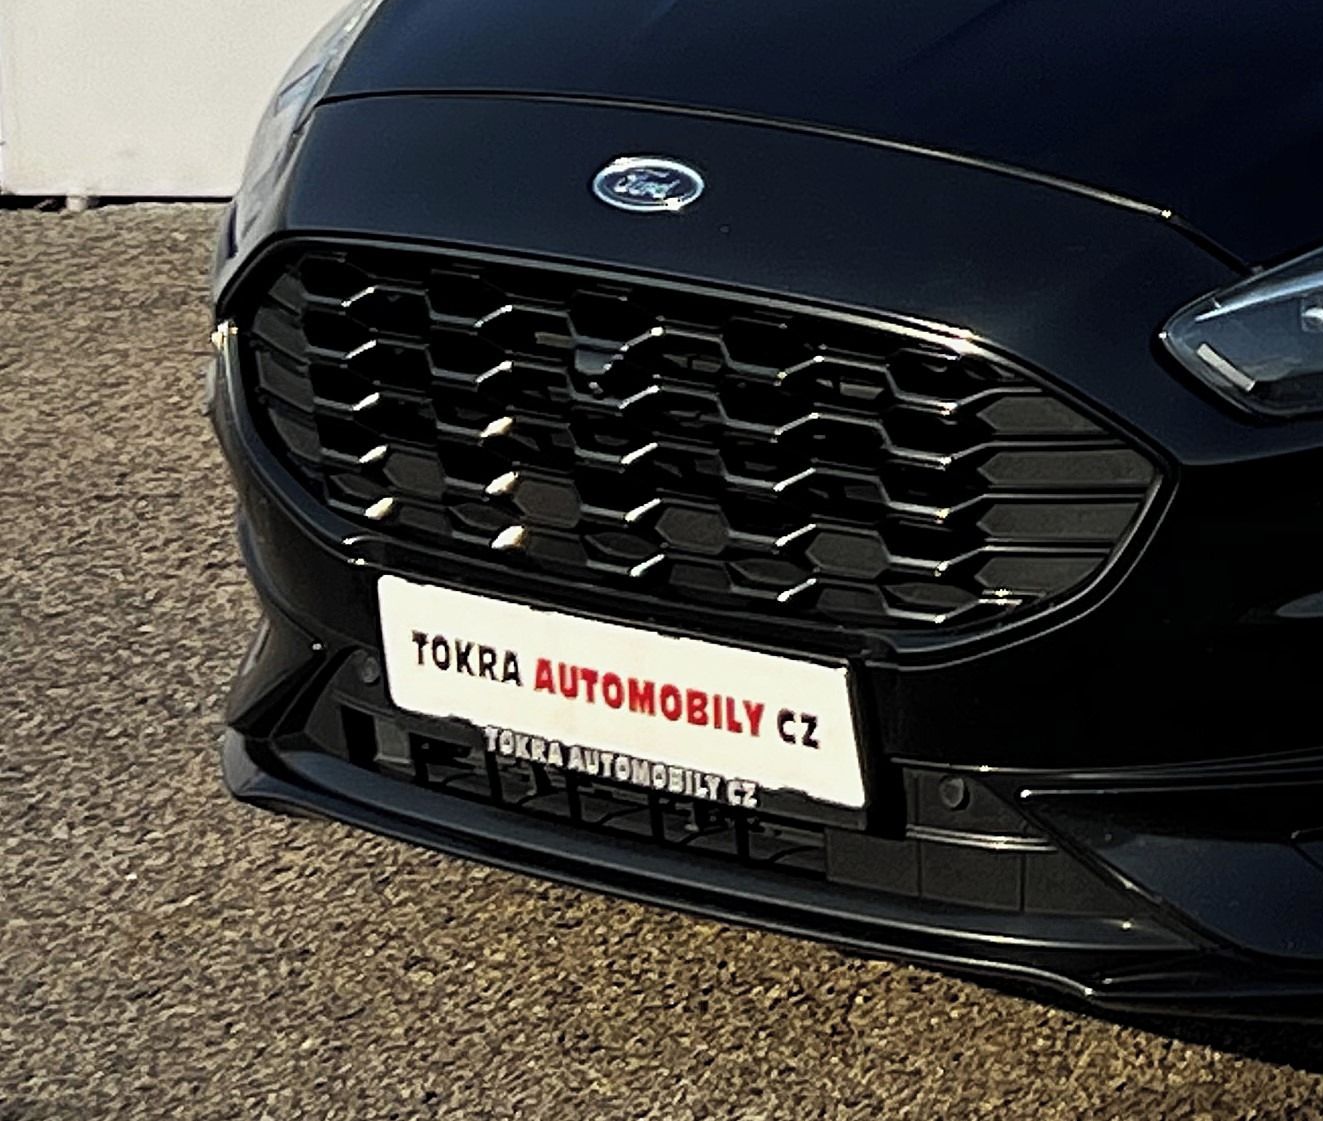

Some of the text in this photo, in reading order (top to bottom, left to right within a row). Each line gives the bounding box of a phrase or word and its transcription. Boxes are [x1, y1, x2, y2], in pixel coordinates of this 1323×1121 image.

[411, 629, 821, 750] TOKRA AUTOMOBILY CZ
[483, 725, 759, 809] TOKRA AUTOMOBILY CZ
